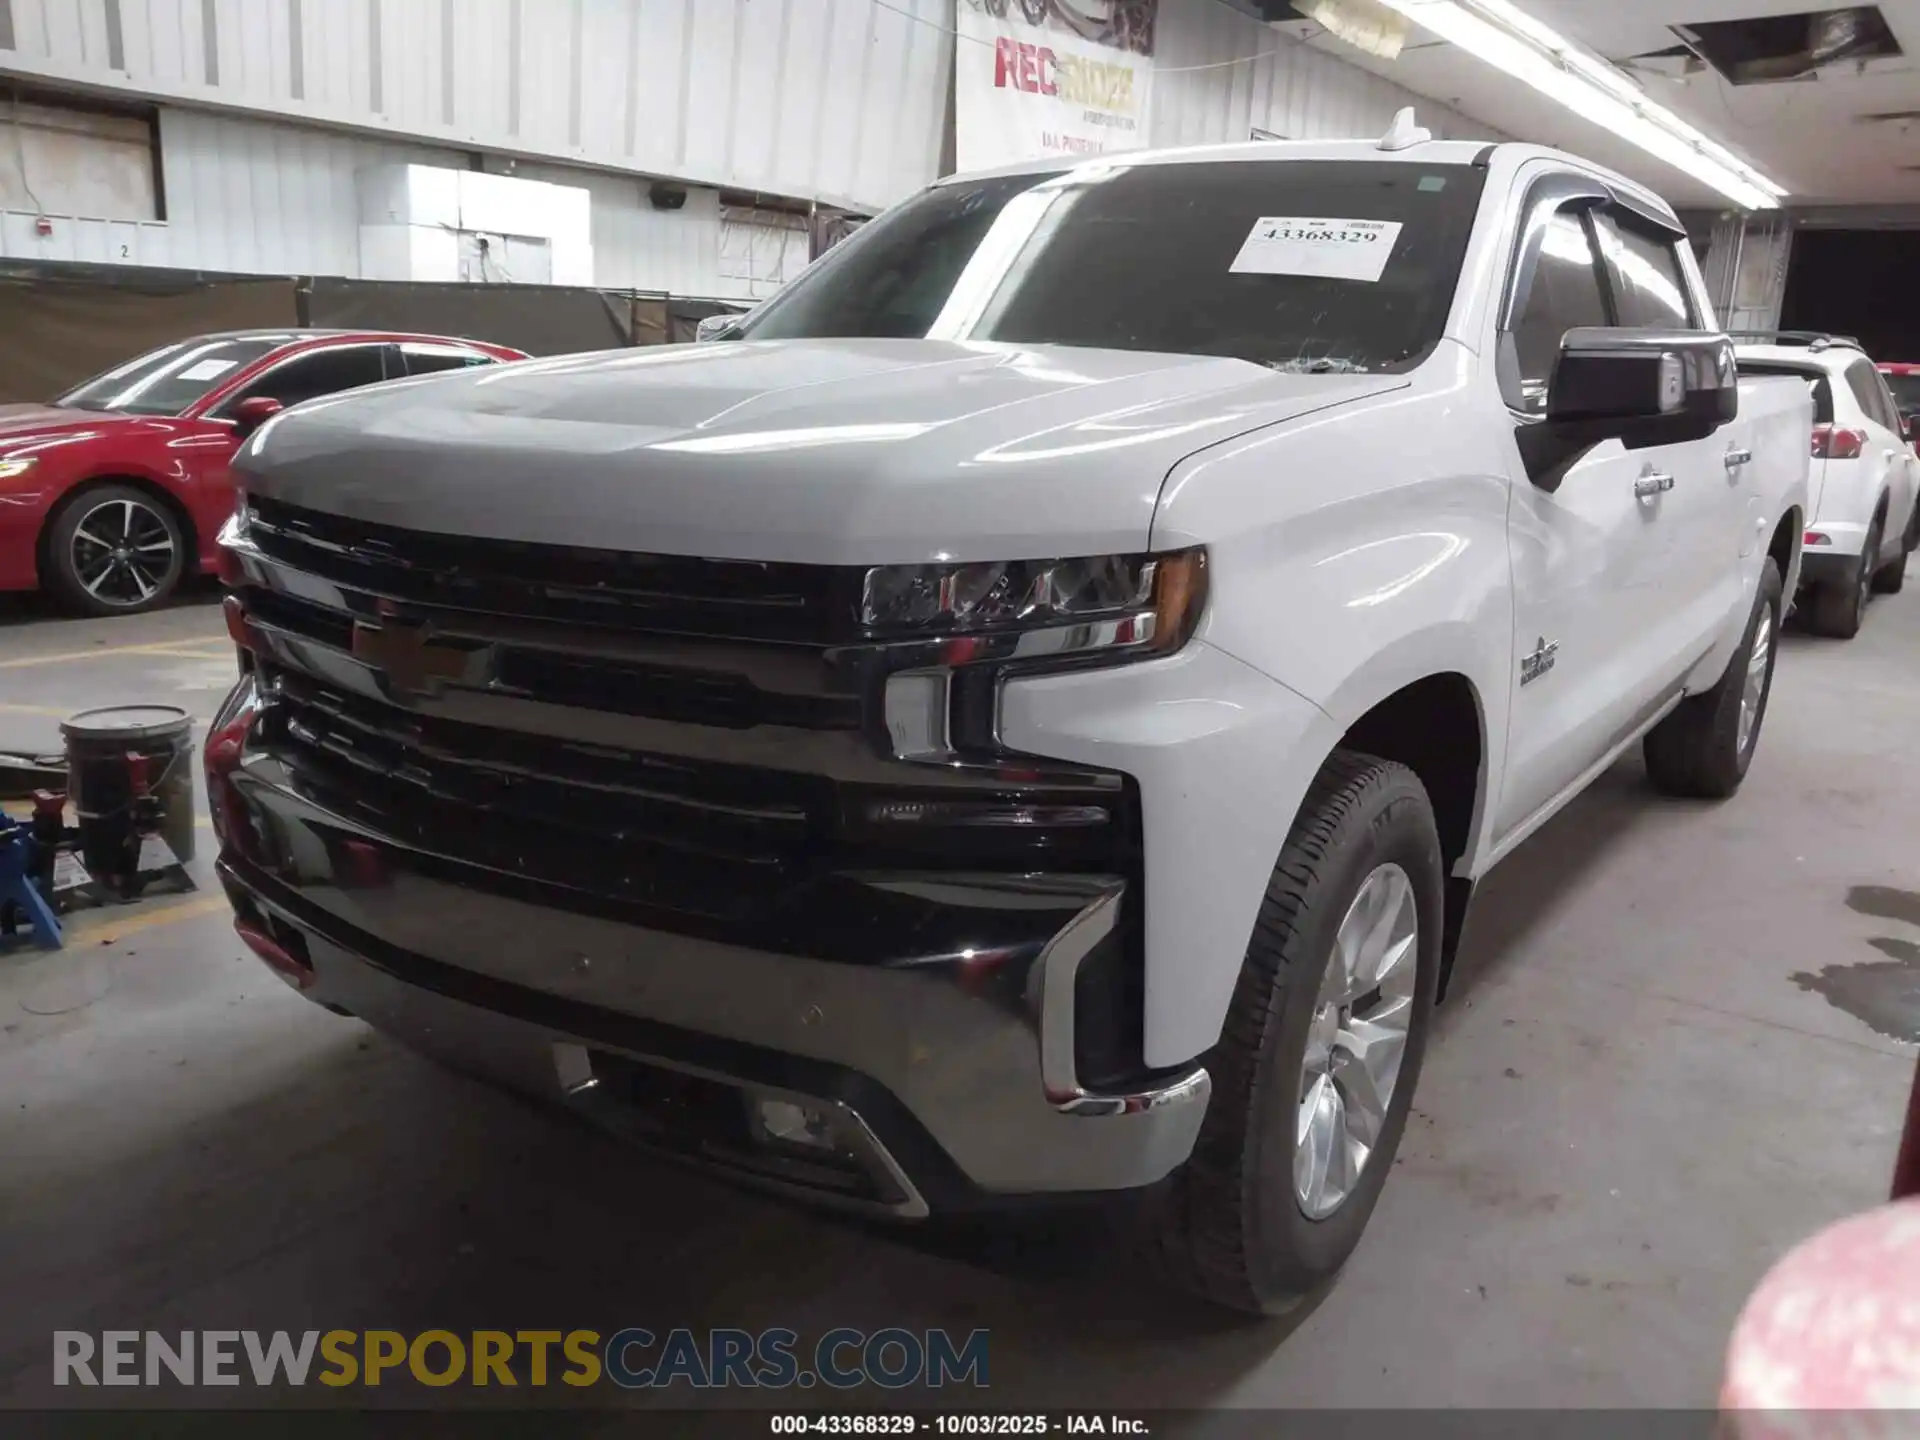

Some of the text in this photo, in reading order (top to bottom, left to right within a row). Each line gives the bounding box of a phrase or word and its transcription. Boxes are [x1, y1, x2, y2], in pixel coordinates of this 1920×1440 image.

[995, 36, 1057, 96] REC
[1264, 228, 1377, 243] 43368329
[121, 244, 130, 258] 2
